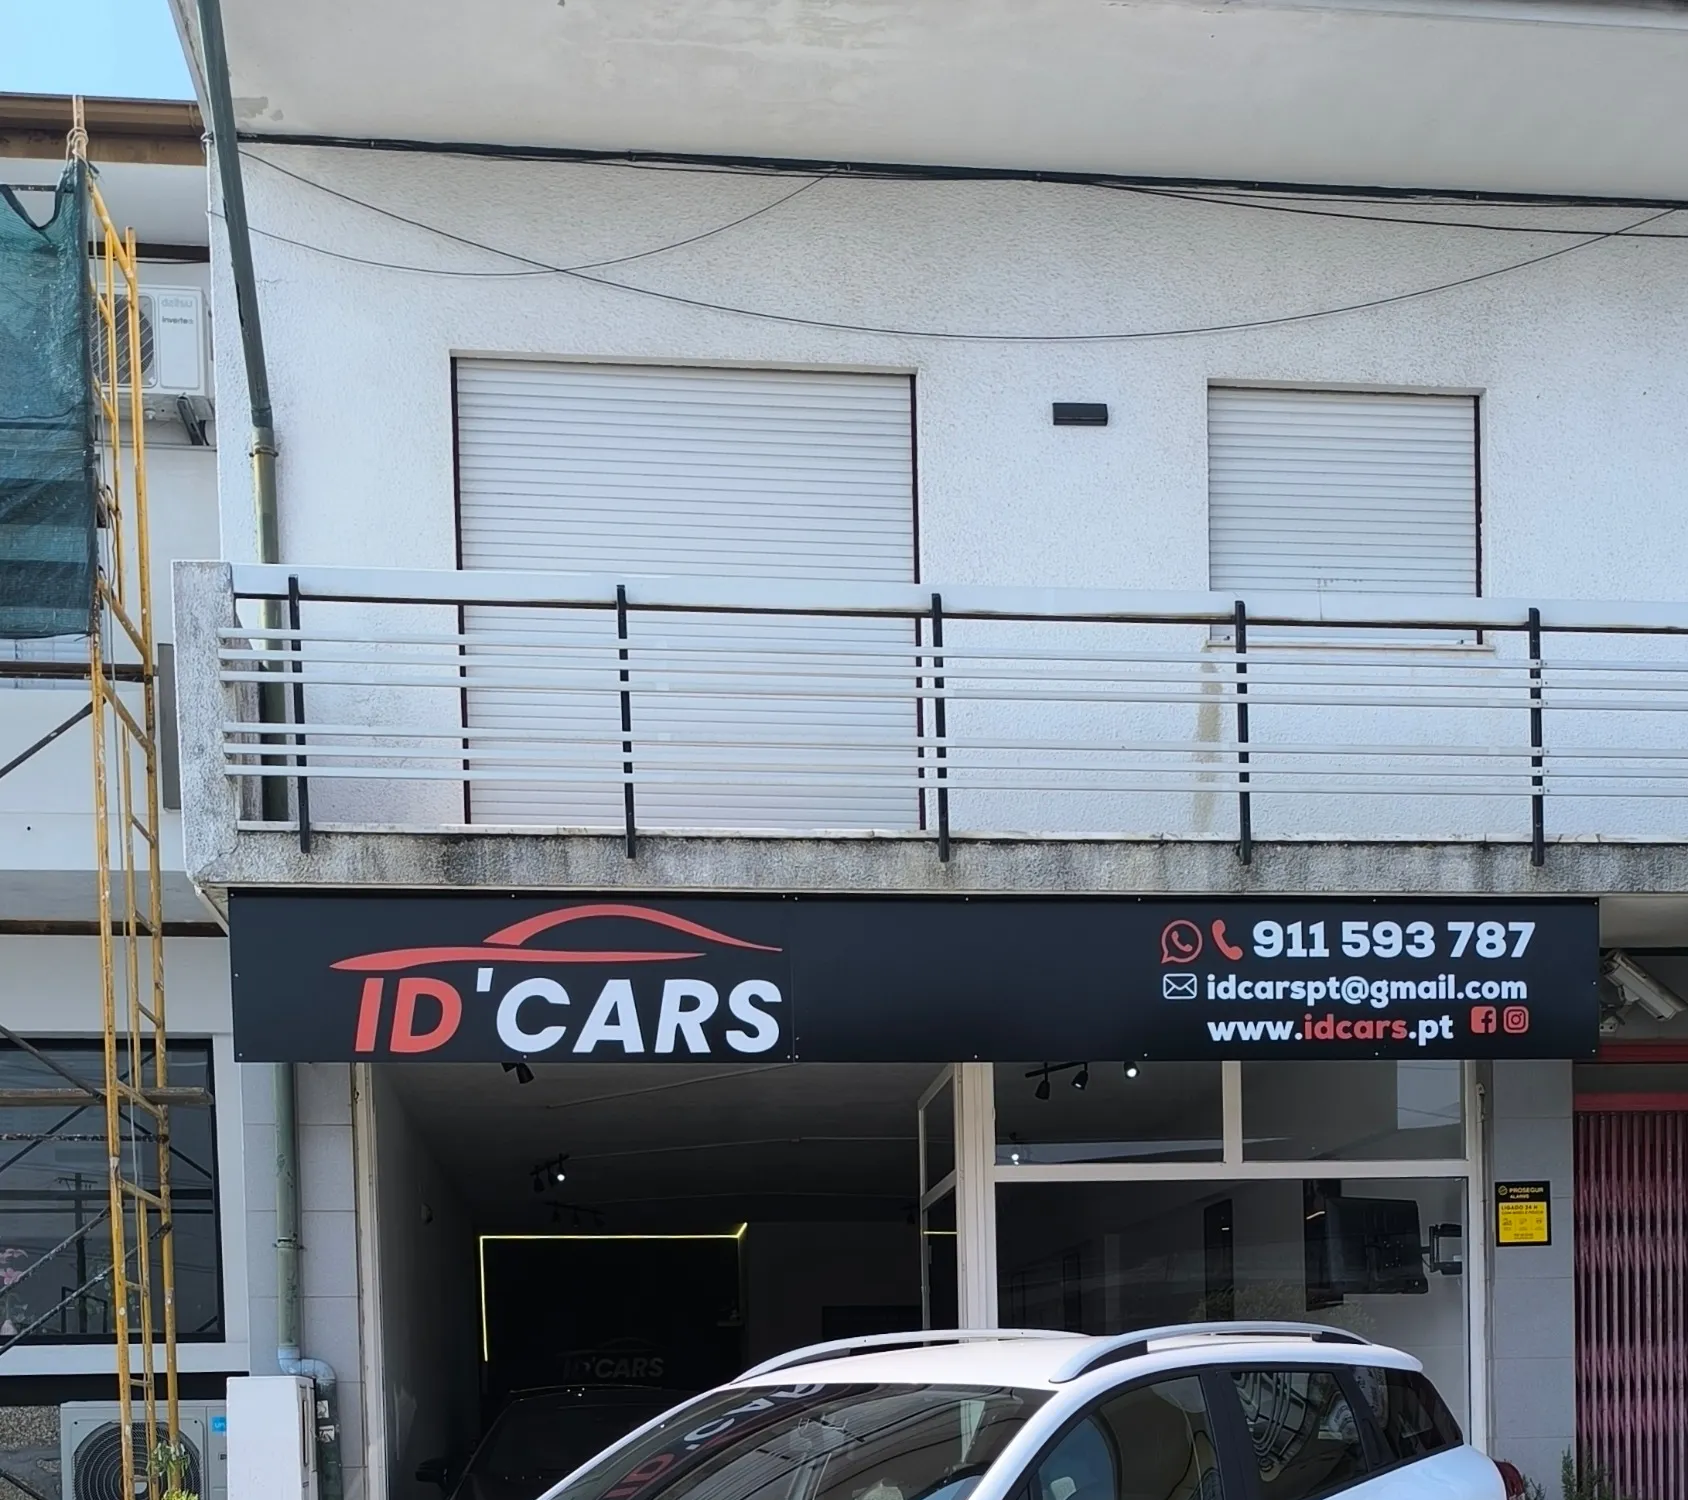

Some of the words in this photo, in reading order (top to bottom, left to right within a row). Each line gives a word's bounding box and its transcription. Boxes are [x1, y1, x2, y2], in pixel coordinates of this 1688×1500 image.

[1252, 920, 1330, 958] 911
[1341, 920, 1436, 958] 593
[1447, 921, 1536, 958] 787
[1207, 973, 1528, 1009] idcarspt@gmail.com
[354, 967, 783, 1054] ID'CARS
[1206, 1013, 1454, 1046] www.idcars.pt
